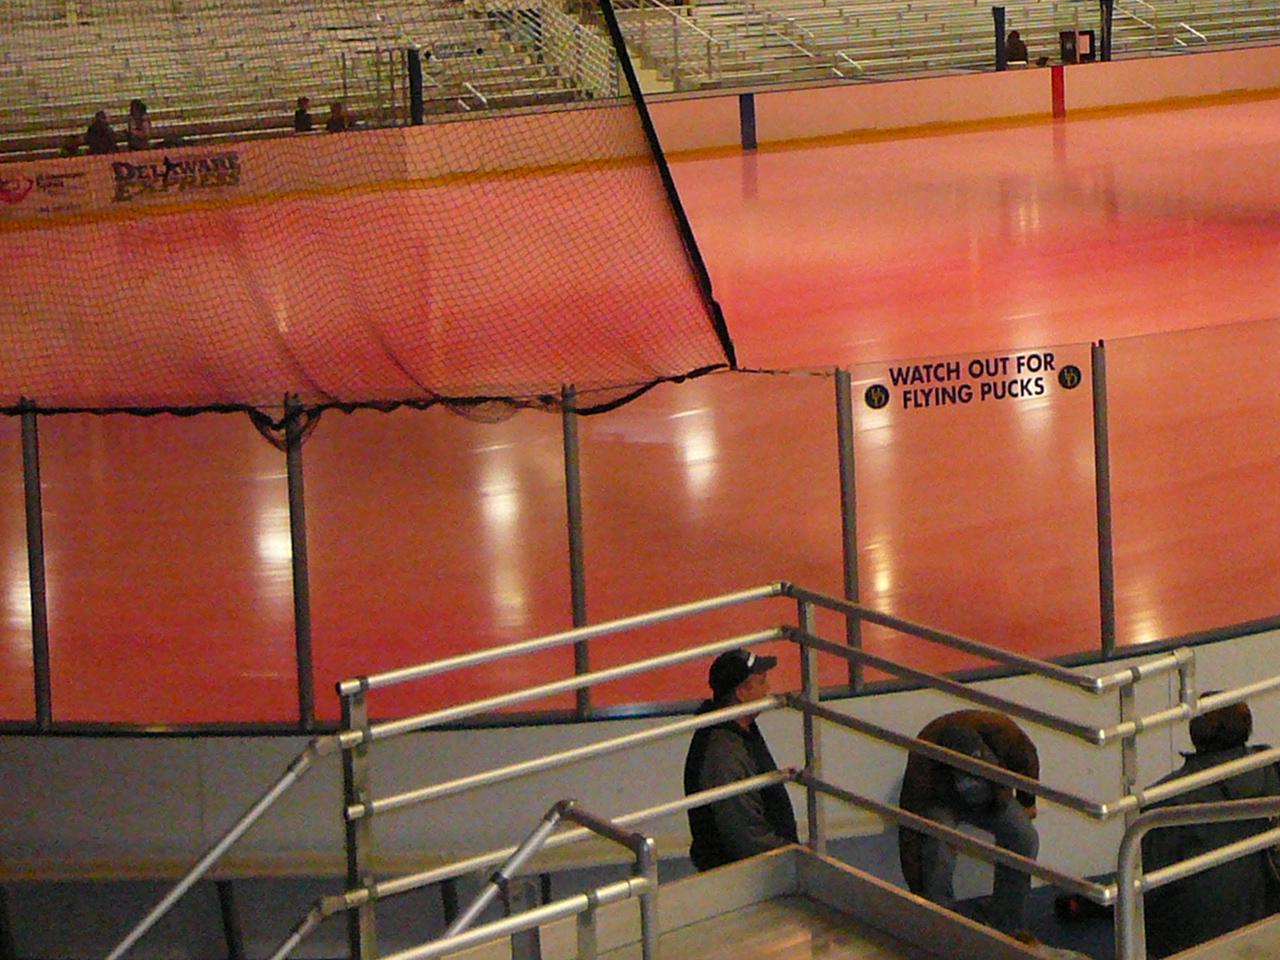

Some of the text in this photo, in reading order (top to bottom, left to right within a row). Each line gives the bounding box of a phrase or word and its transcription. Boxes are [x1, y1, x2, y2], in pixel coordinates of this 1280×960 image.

[889, 352, 1055, 387] WATCH OUT FOR
[902, 376, 1045, 410] FLYING PUCKS
